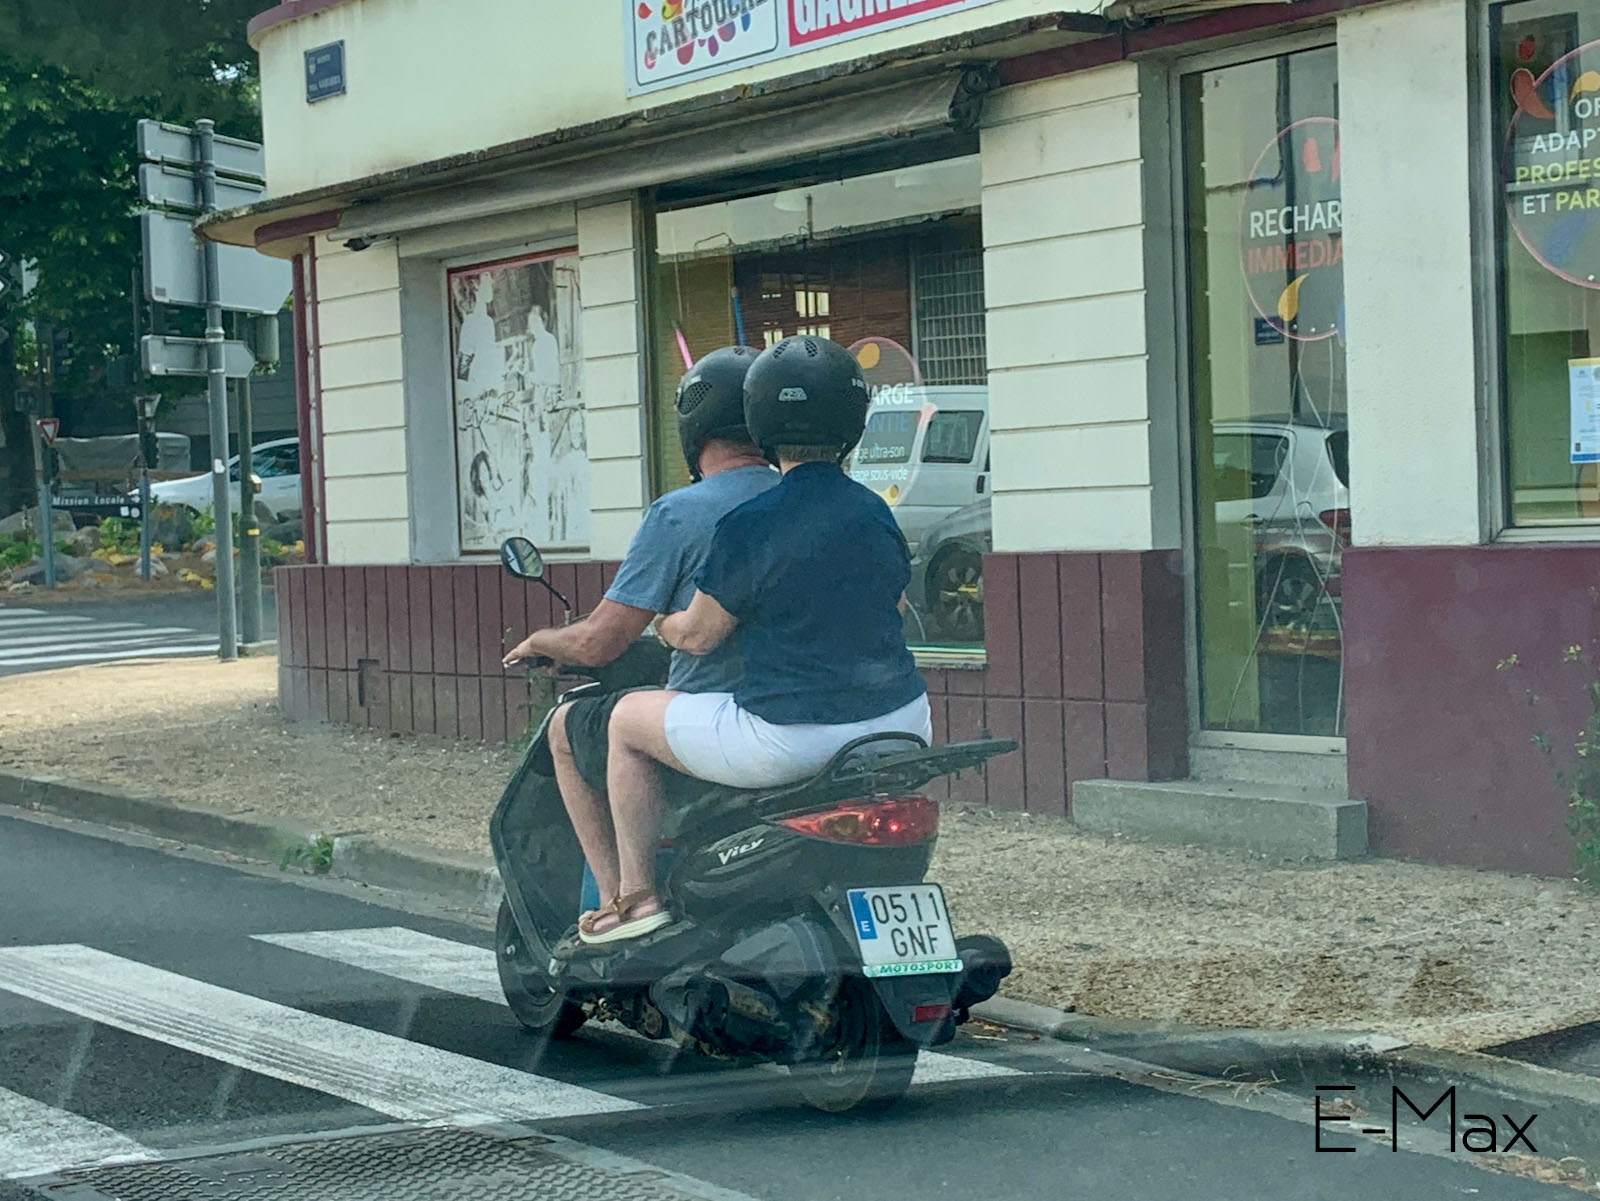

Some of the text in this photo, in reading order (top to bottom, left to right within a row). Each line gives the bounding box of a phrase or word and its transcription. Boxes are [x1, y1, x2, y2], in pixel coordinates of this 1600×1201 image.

[1531, 127, 1600, 155] ADAP
[1523, 187, 1600, 215] ET PAR
[1250, 200, 1343, 239] RECHAR
[867, 381, 915, 406] ARGE
[52, 495, 125, 506] Mission Locale
[871, 892, 941, 924] 0511
[860, 920, 871, 932] E
[891, 924, 939, 957] GNF
[879, 960, 960, 974] MOTOSPORT
